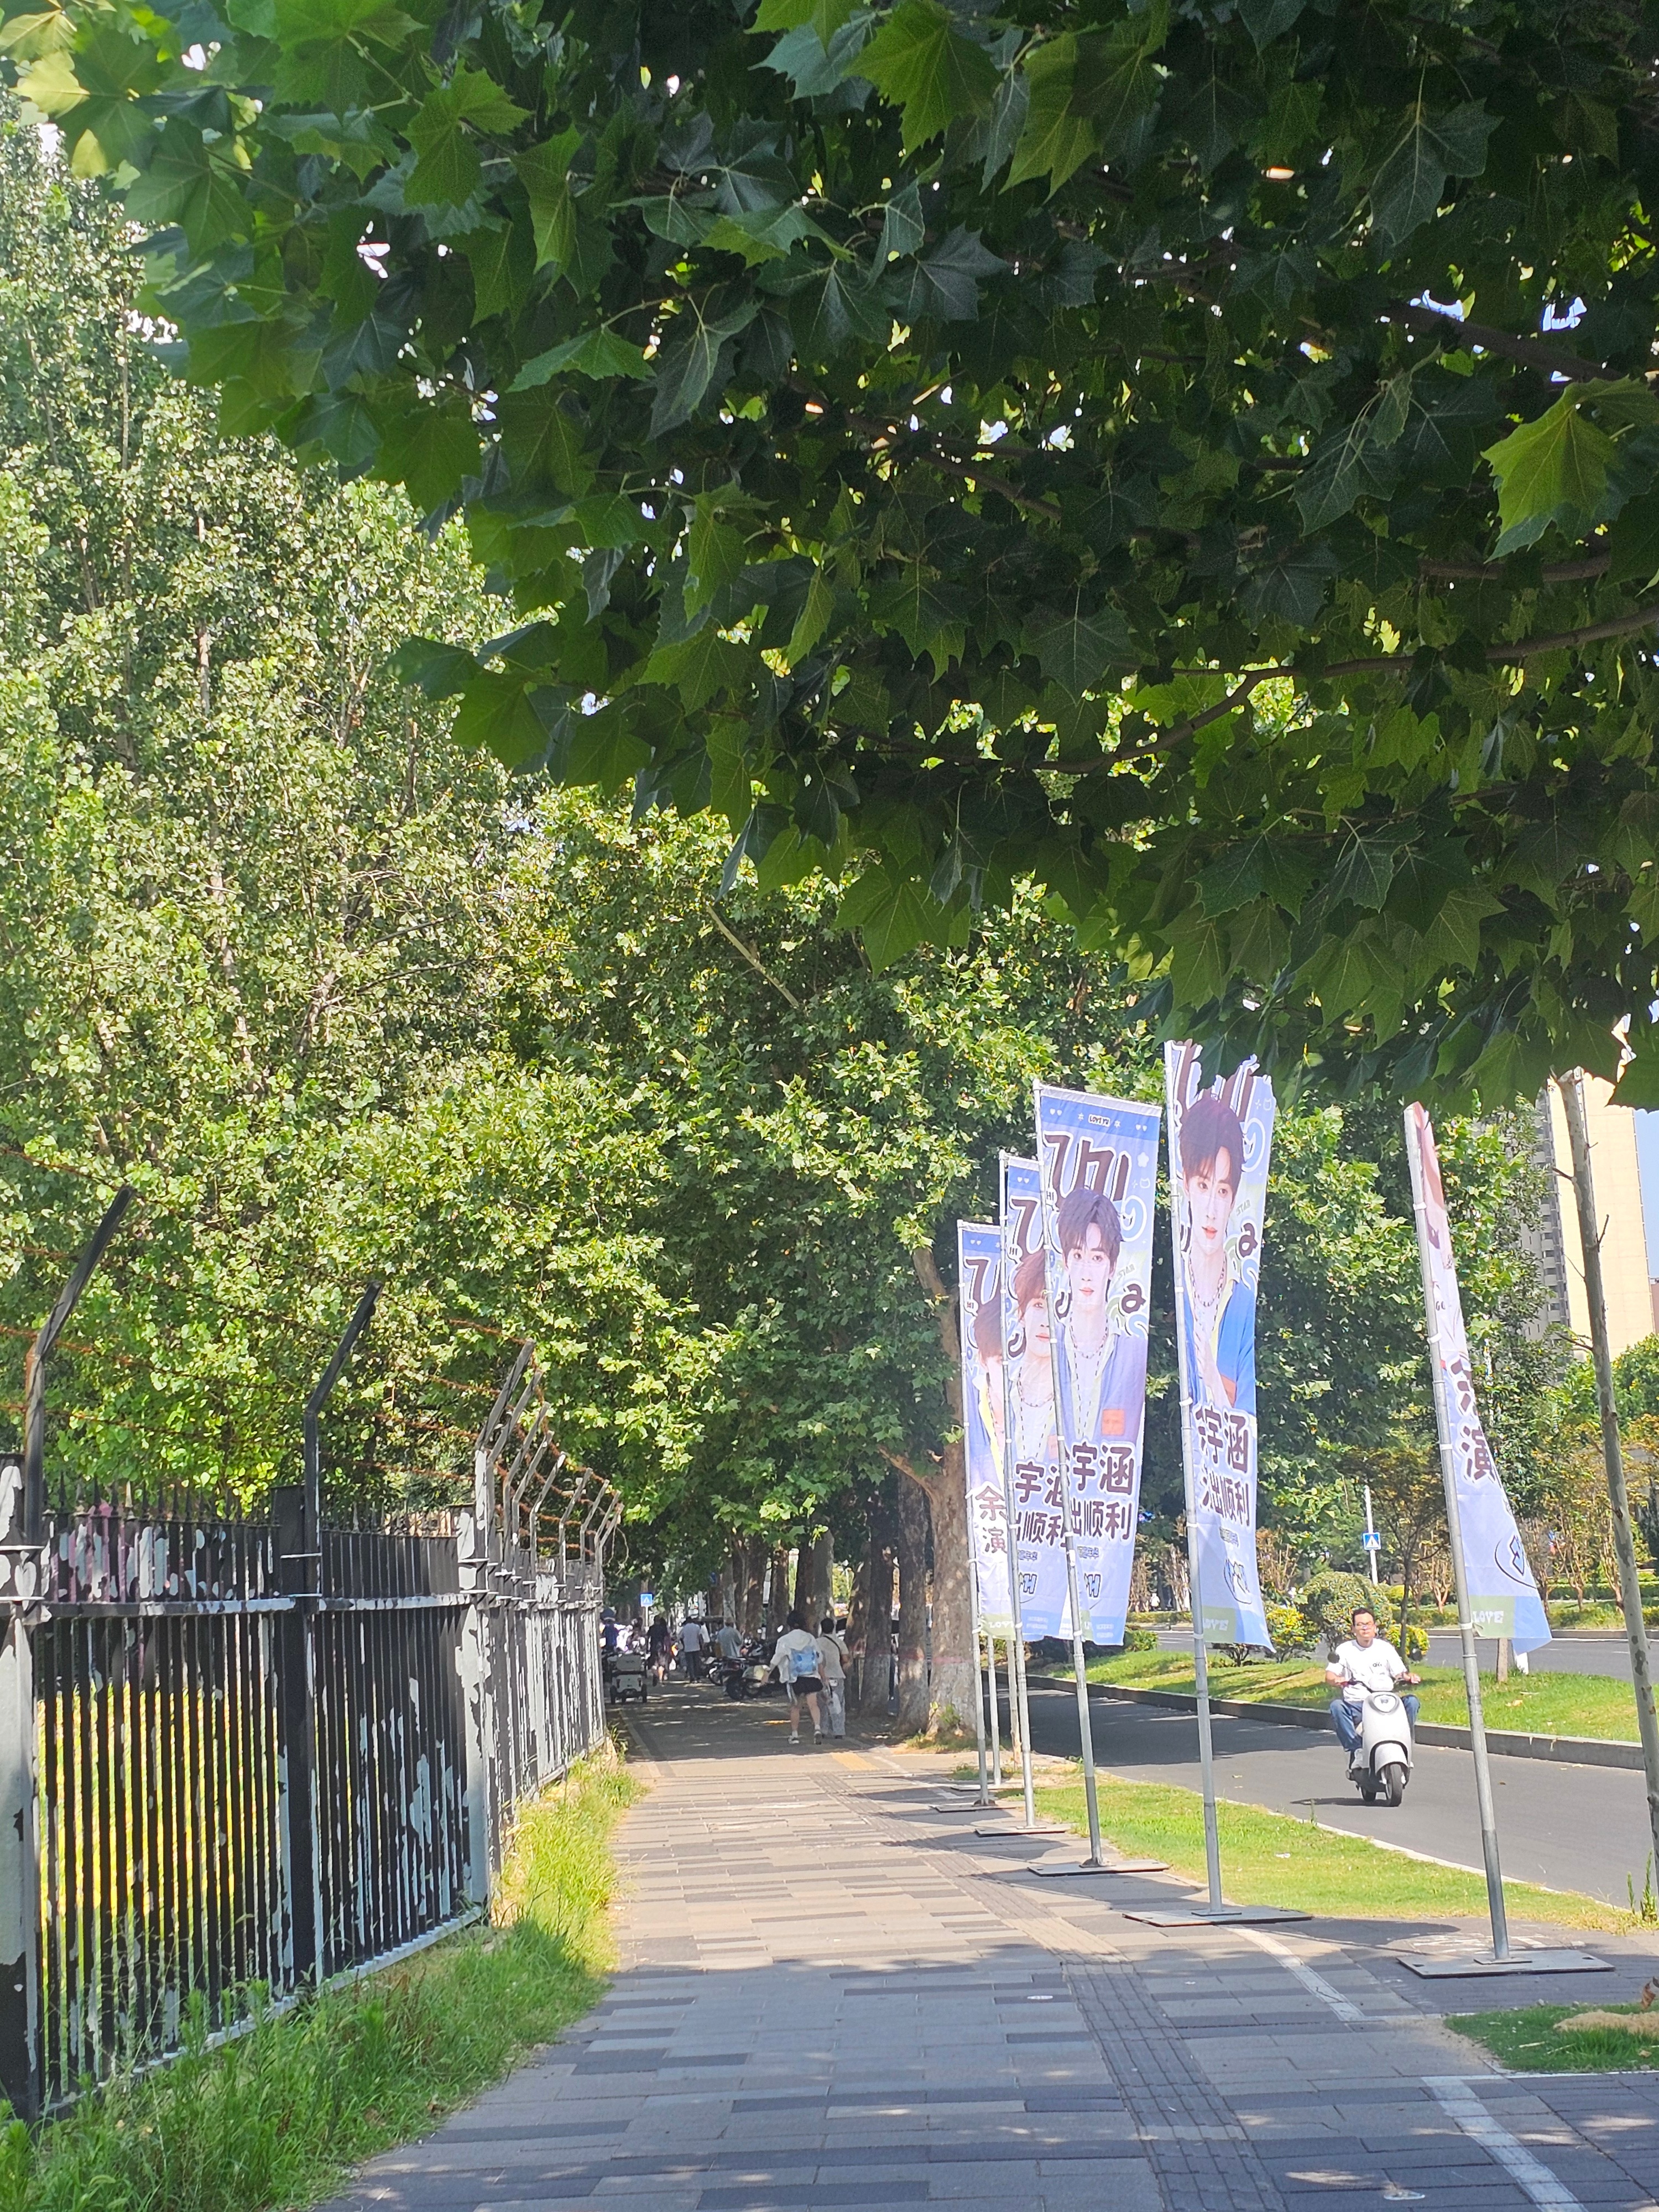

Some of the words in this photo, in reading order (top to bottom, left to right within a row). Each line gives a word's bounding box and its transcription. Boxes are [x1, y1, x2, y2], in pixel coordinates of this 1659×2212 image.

[1065, 1441, 1134, 1495] 宇涵
[1473, 1610, 1504, 1624] LOVE
[1203, 1618, 1228, 1631] OVE
